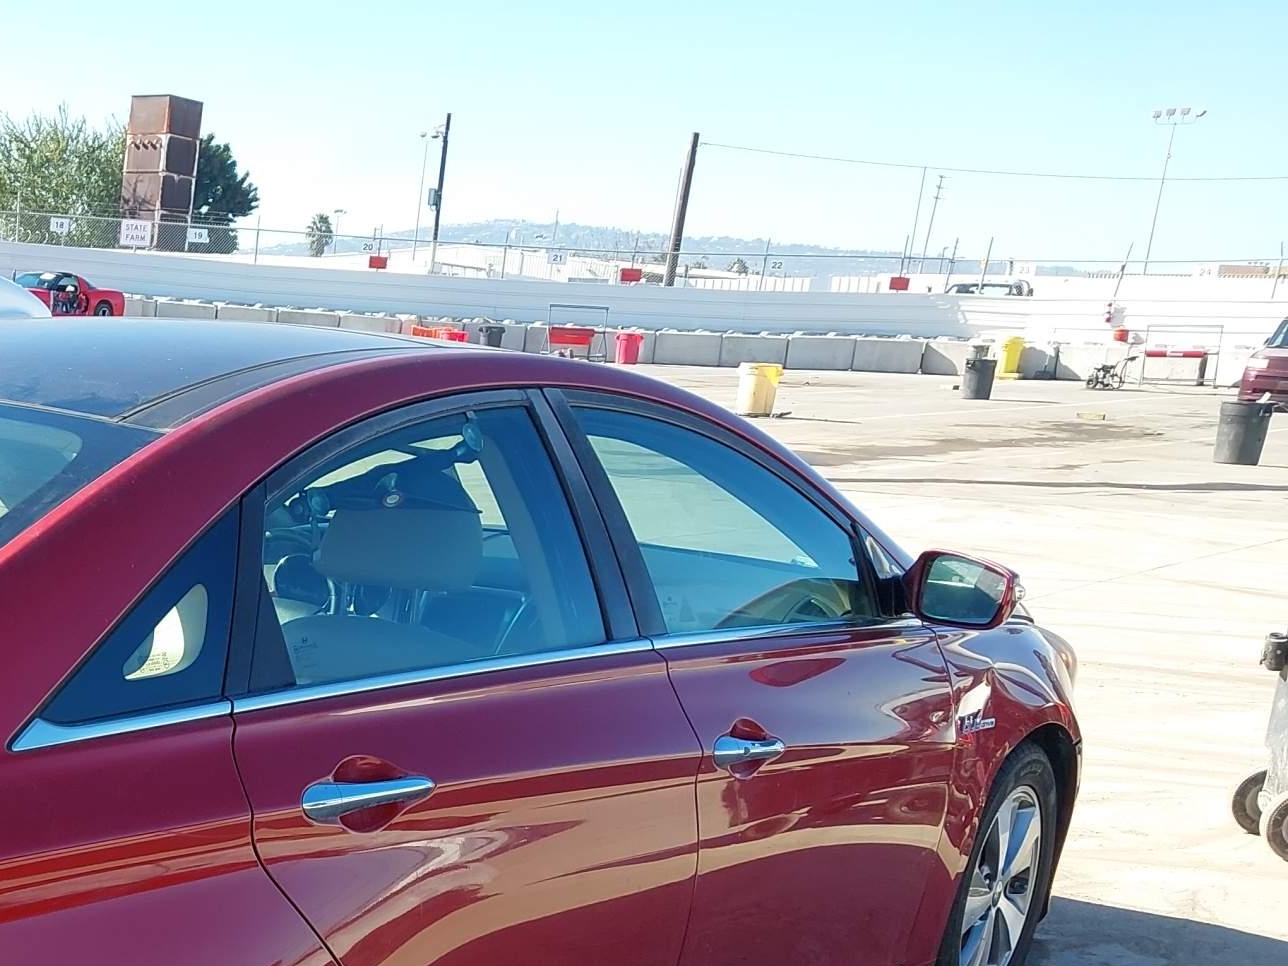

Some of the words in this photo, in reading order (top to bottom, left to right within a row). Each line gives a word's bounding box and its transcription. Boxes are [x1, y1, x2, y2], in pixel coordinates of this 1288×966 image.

[125, 223, 148, 233] STATE
[125, 233, 147, 242] FARM
[363, 243, 374, 251] 20
[552, 254, 563, 263] 21
[771, 261, 783, 270] 22
